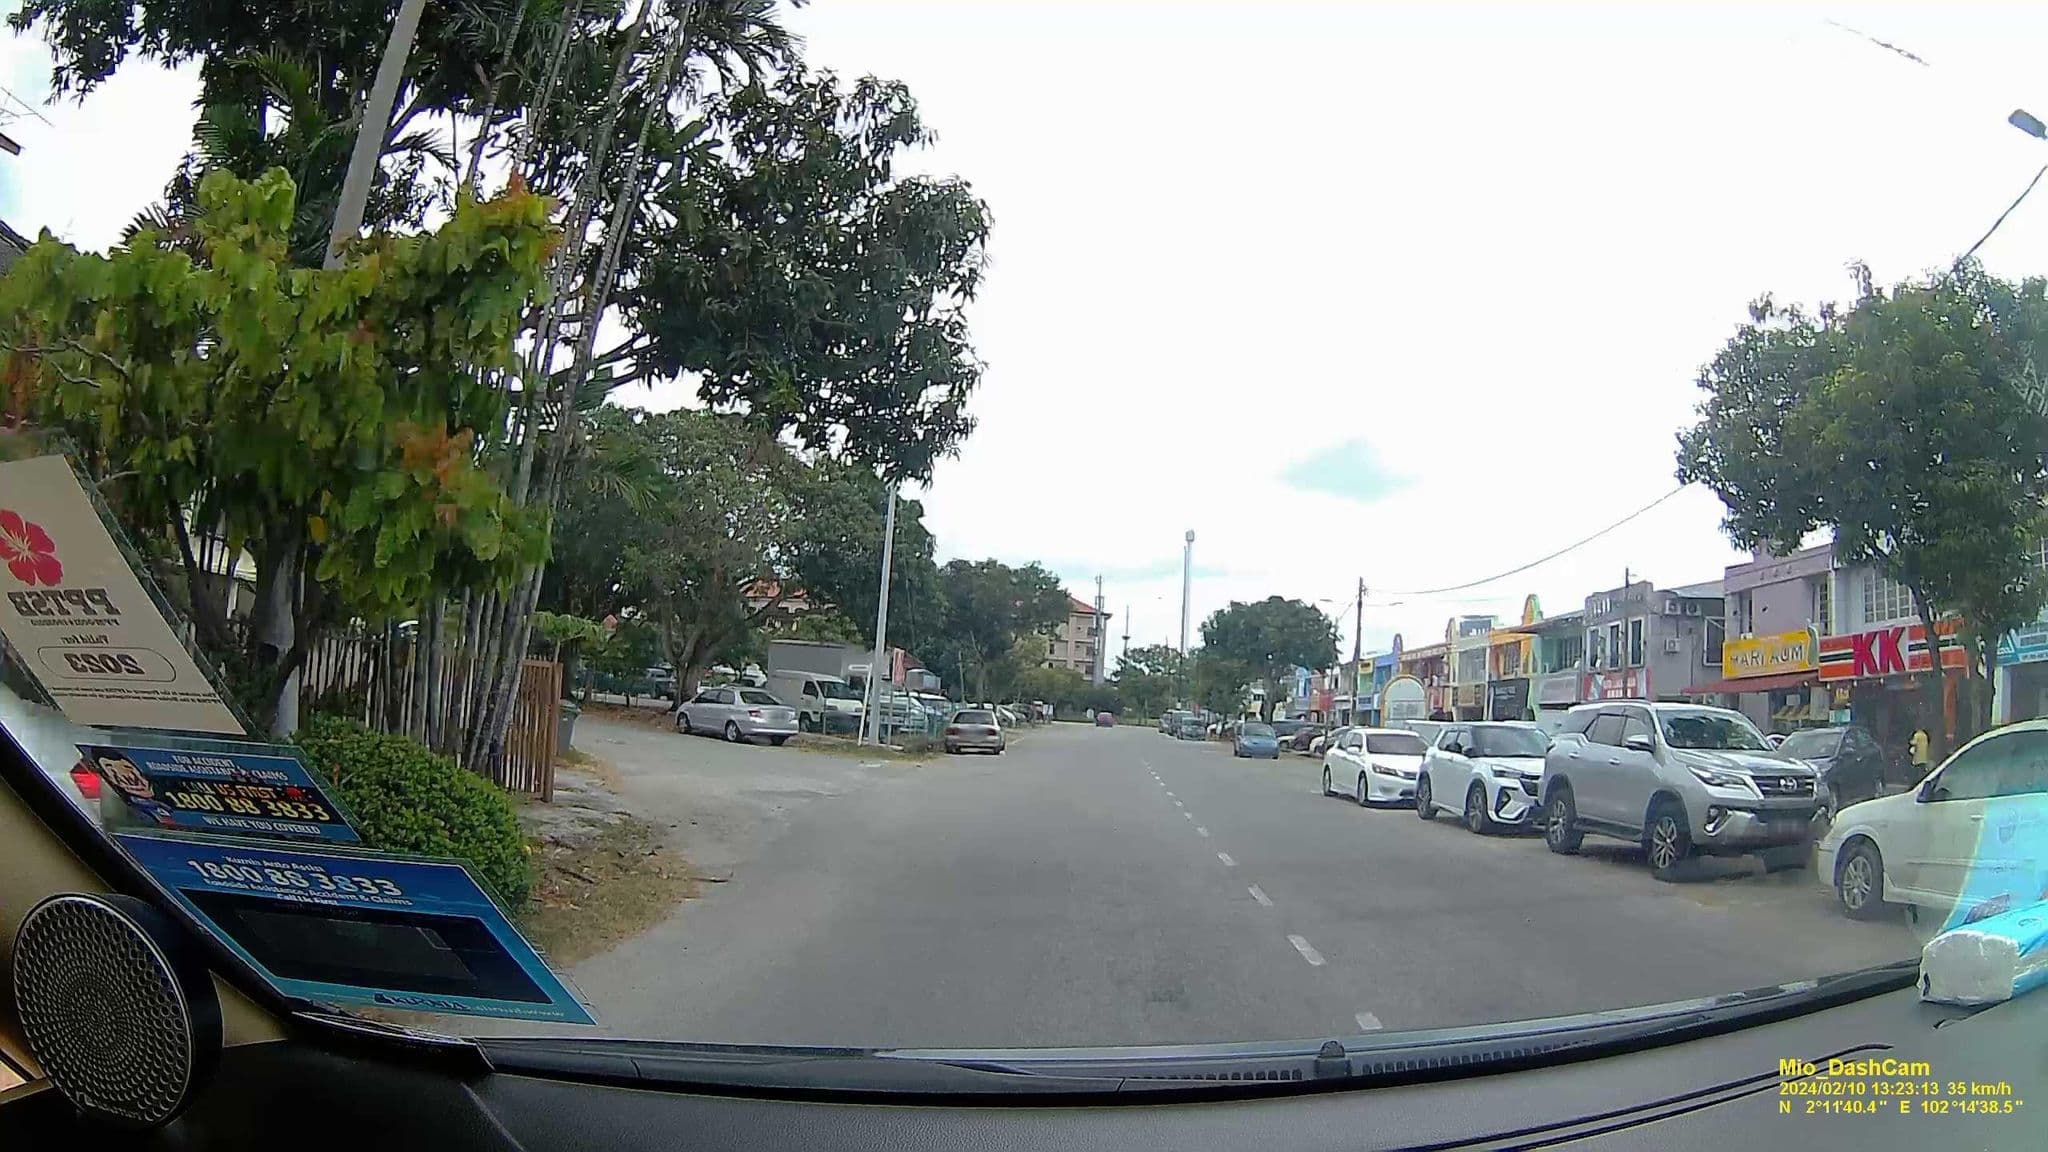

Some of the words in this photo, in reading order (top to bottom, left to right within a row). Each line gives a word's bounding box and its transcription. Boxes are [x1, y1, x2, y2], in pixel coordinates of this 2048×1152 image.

[1852, 627, 1907, 675] KK
[192, 757, 237, 769] ACCIDENT
[251, 769, 289, 782] CLAIMS
[214, 783, 236, 796] US
[235, 785, 278, 799] FIRST
[165, 791, 224, 812] 1800
[225, 796, 261, 815] 88
[261, 800, 331, 821] 3833
[201, 816, 220, 827] WE
[220, 817, 249, 829] HAVE
[248, 819, 273, 831] YOU
[273, 821, 321, 835] COVERED
[187, 860, 263, 883] 1800
[310, 871, 402, 896] 3833
